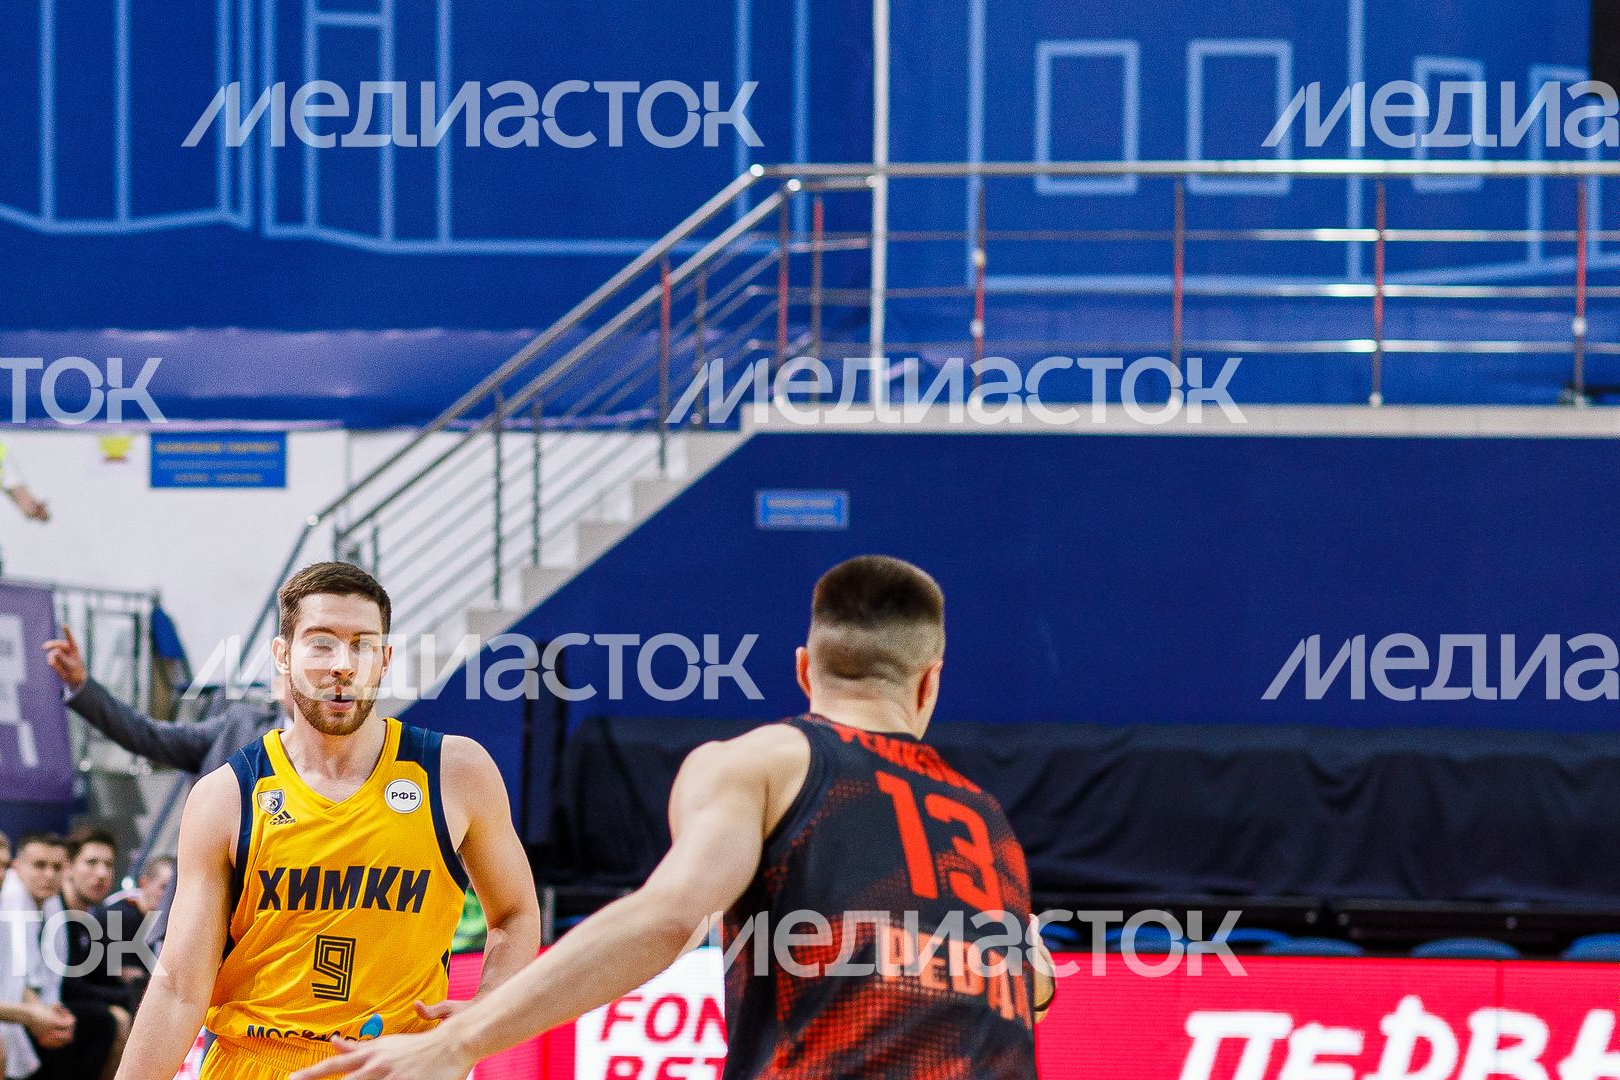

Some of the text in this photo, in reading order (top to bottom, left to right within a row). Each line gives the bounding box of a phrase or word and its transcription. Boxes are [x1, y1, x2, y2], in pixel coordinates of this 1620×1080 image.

[391, 791, 417, 801] РФБ
[874, 770, 1004, 922] 13
[257, 864, 431, 915] ХИМКИ
[311, 934, 357, 1002] 9
[600, 992, 727, 1044] FON
